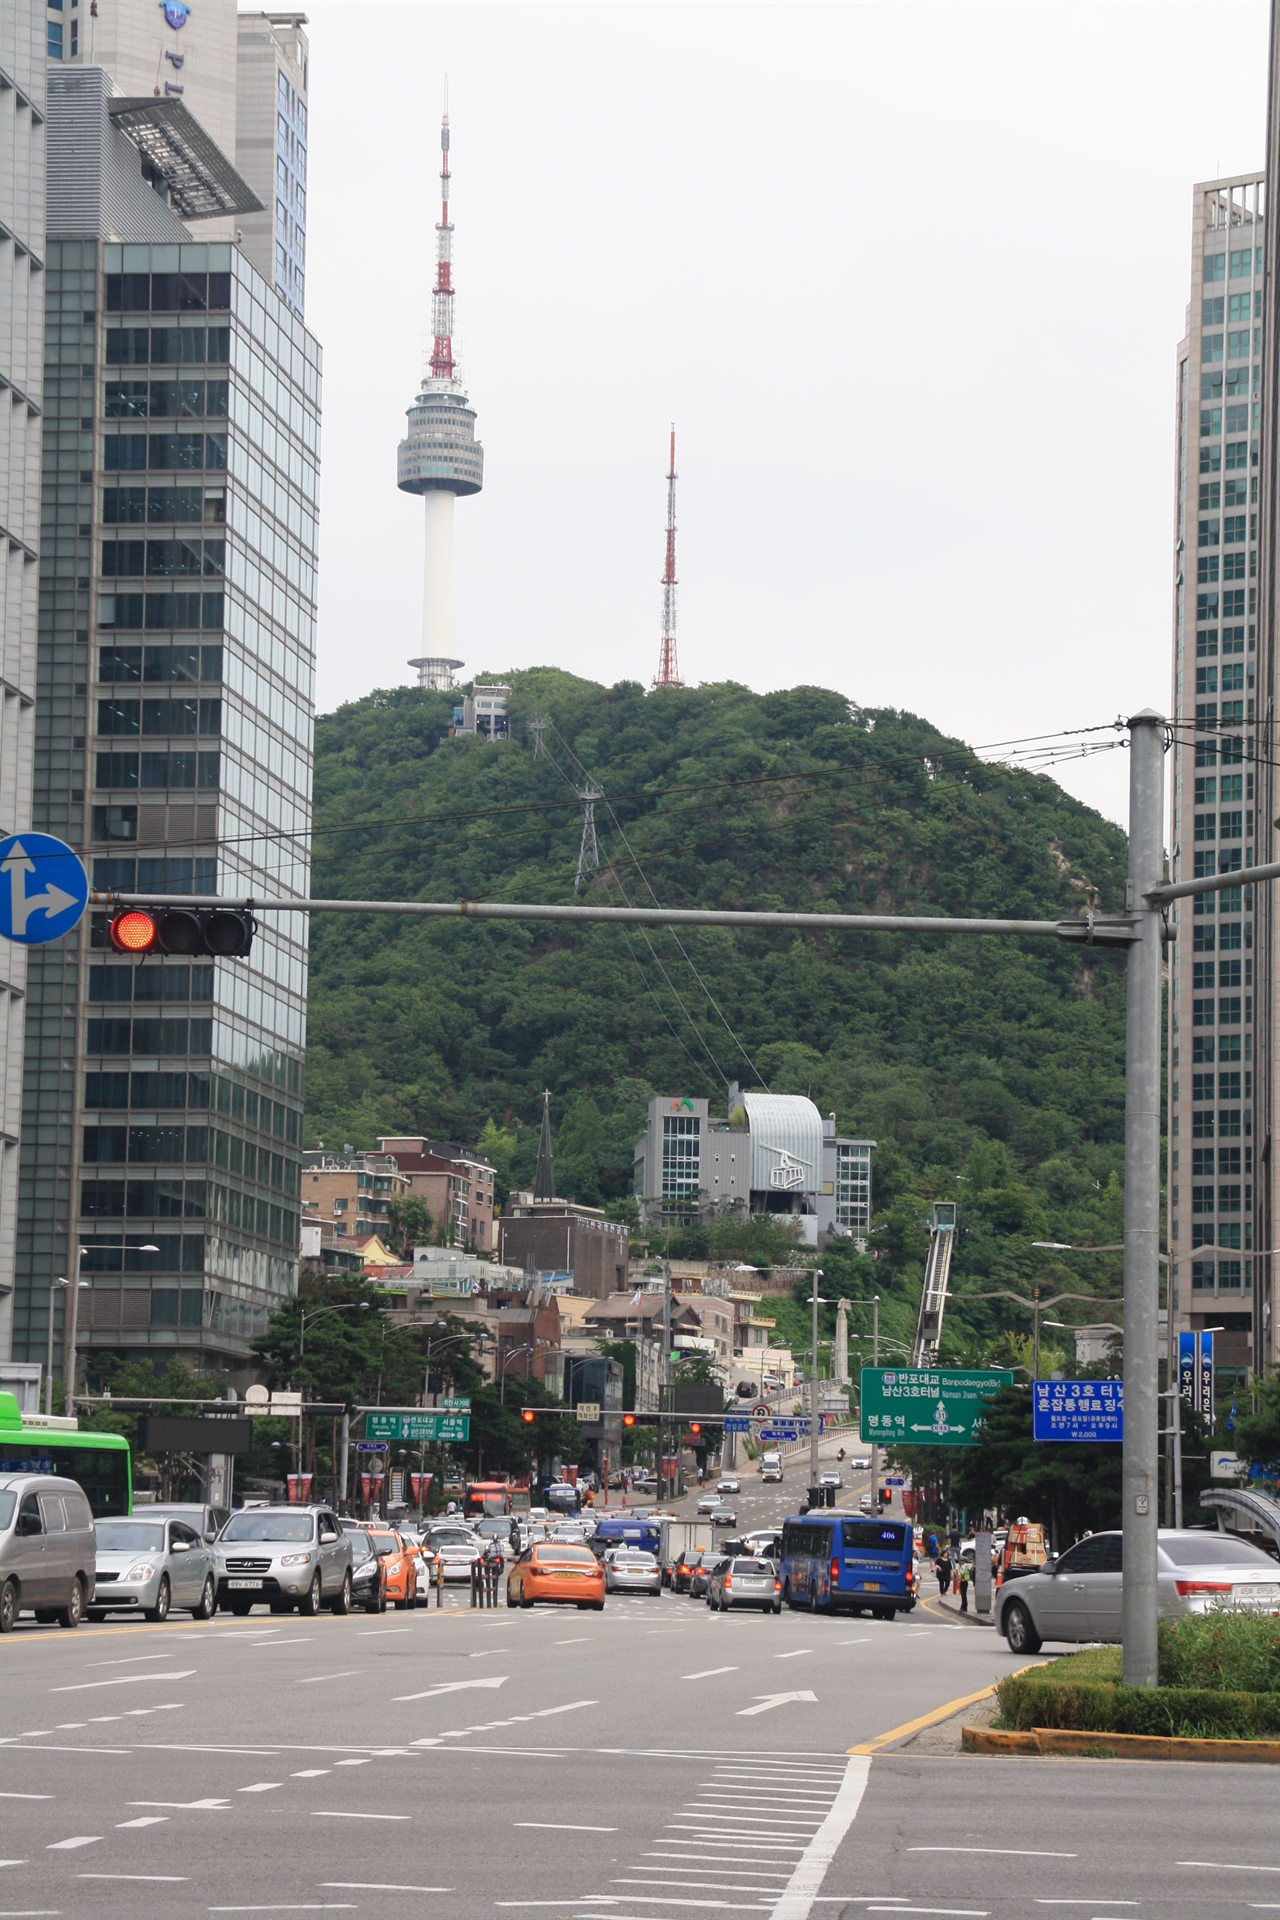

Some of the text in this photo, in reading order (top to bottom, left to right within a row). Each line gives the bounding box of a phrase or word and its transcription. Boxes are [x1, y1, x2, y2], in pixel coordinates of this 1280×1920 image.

[899, 1373, 939, 1384] 반포대교
[882, 1386, 939, 1398] 남산3호터널
[868, 1415, 905, 1427] 명동역
[868, 1428, 896, 1437] Myeongdong
[881, 1531, 895, 1539] 406
